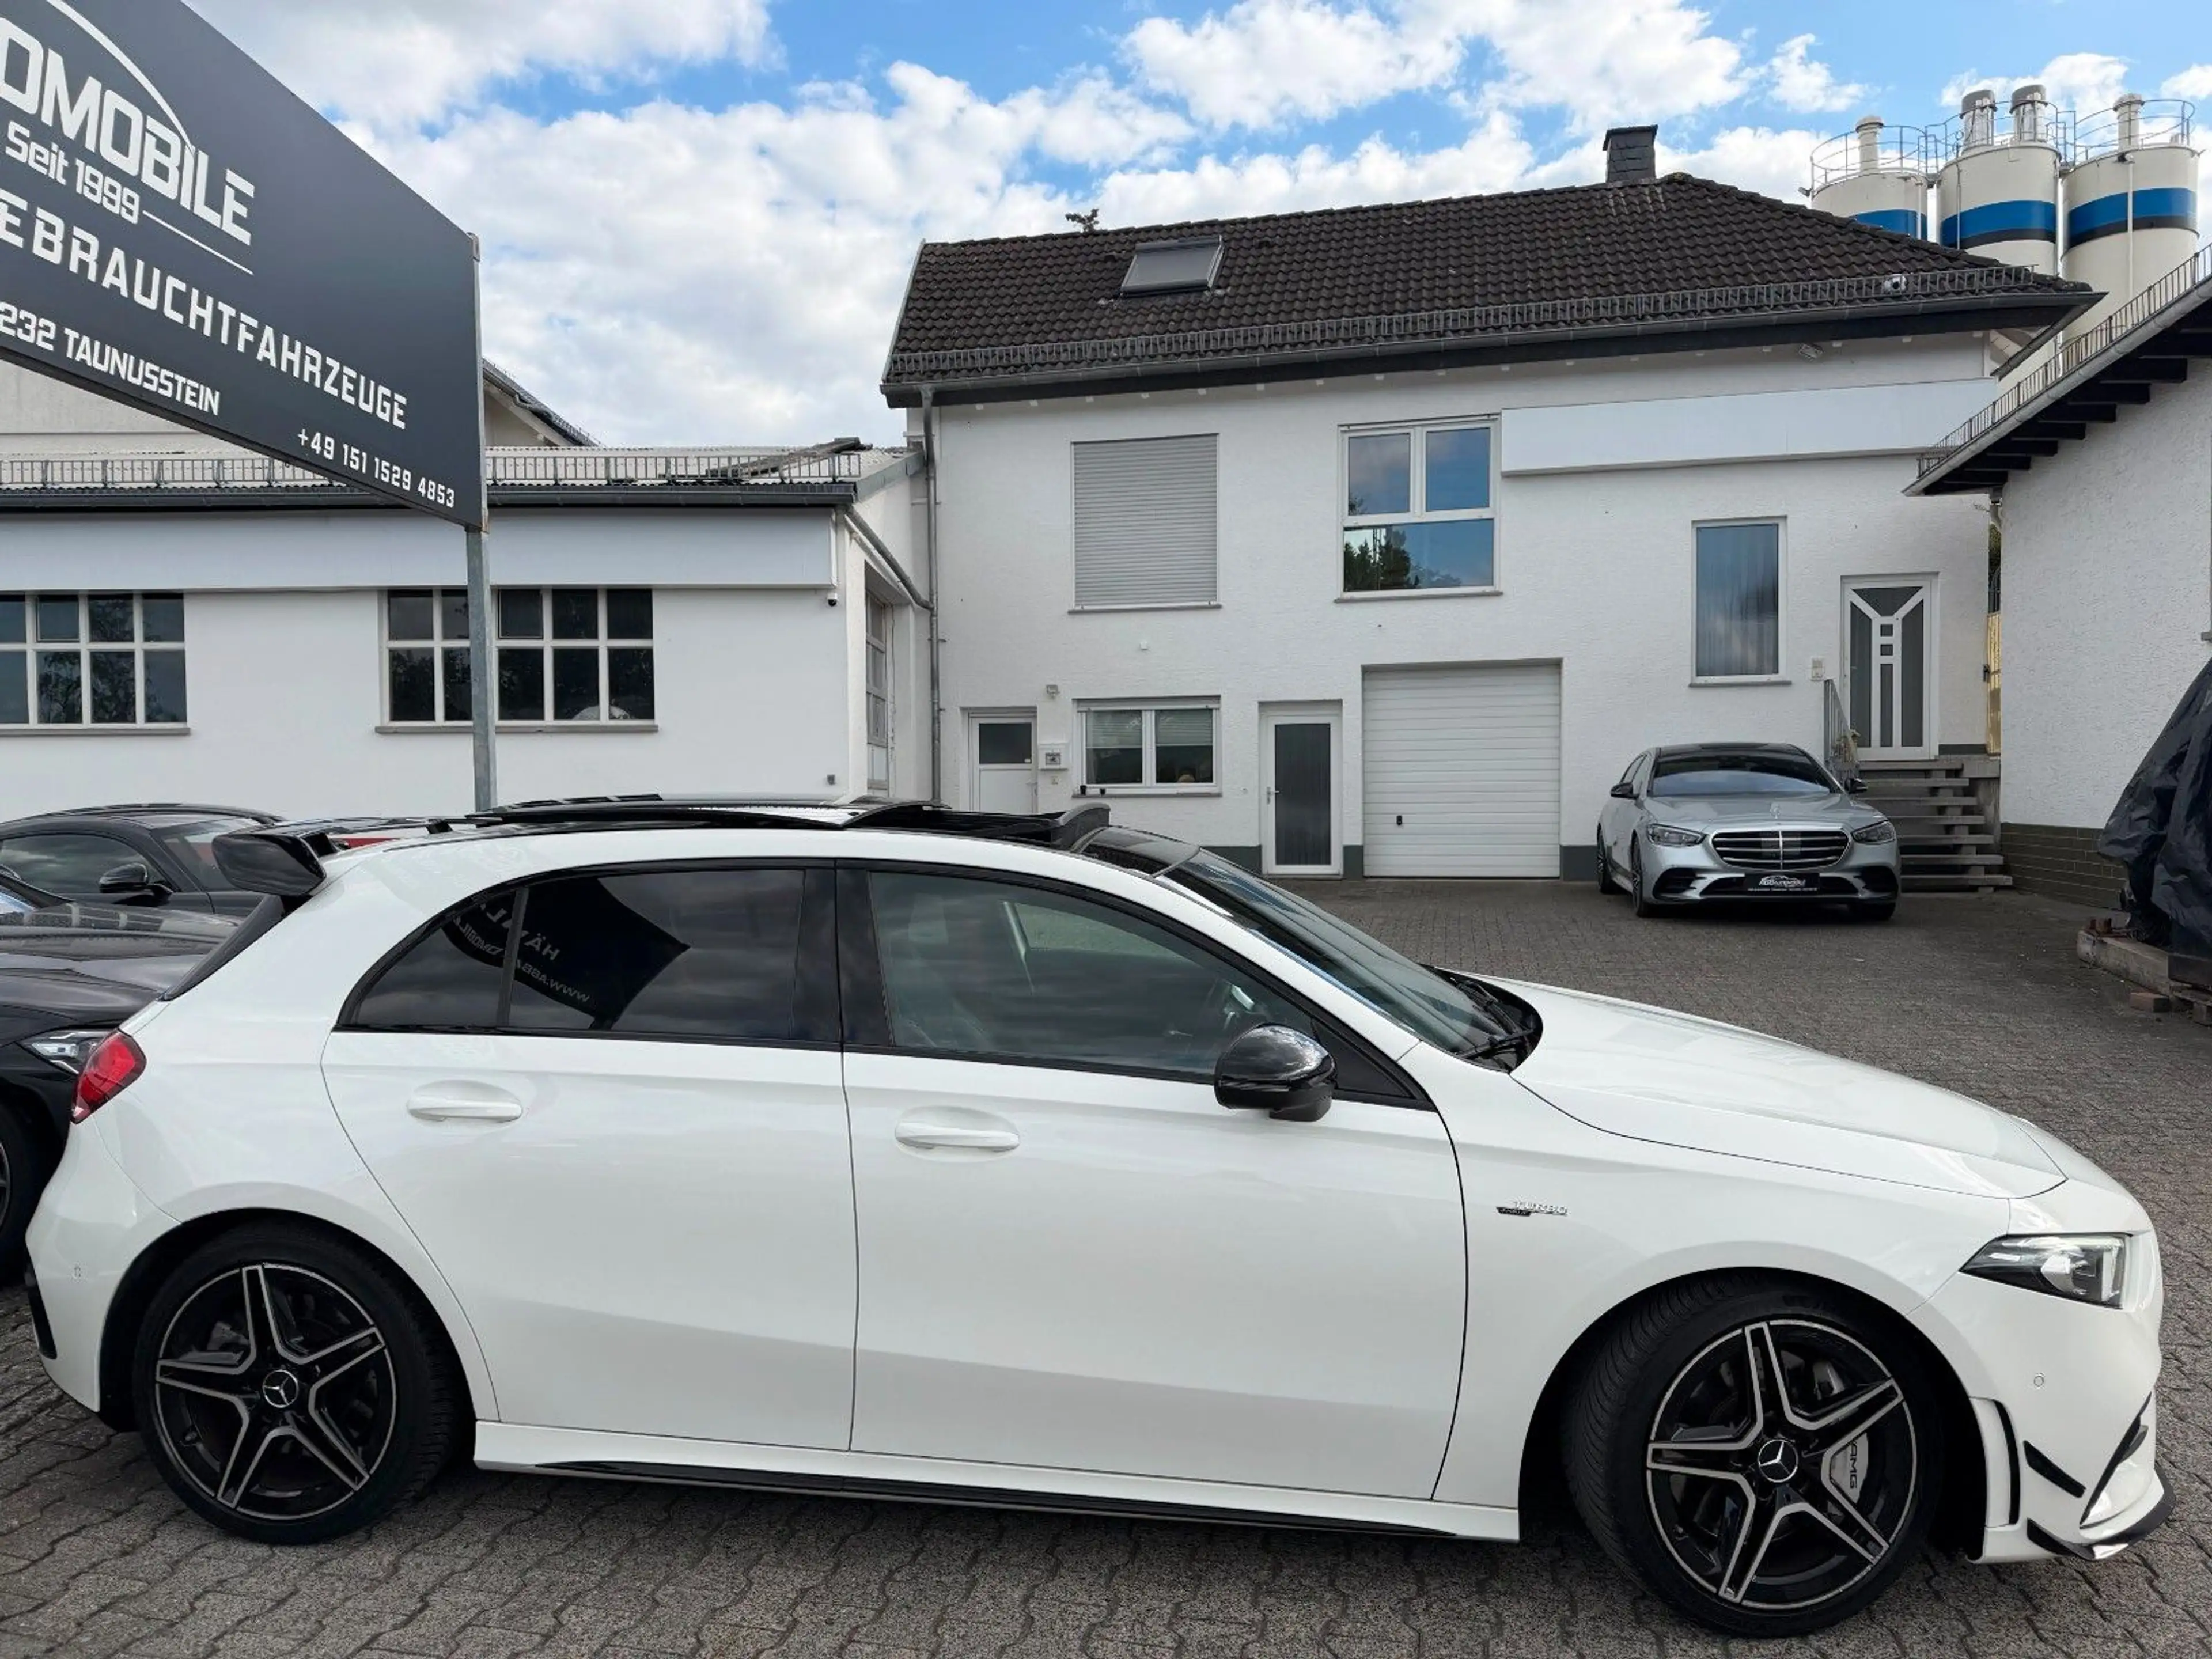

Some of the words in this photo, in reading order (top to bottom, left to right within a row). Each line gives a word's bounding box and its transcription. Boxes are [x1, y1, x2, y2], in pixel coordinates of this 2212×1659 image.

[0, 17, 255, 245] OMOBILE
[5, 121, 69, 185] Seit
[75, 158, 141, 224] 1999
[0, 188, 407, 430] EBRAUCHTFAHRZEUGE
[0, 301, 56, 351] 232
[64, 327, 220, 415] TAUNUSSTEIN
[298, 428, 335, 460] +49
[343, 444, 367, 474] 151
[374, 457, 411, 491] 1529
[417, 477, 454, 508] 4853
[1849, 1442, 1858, 1489] AMG
